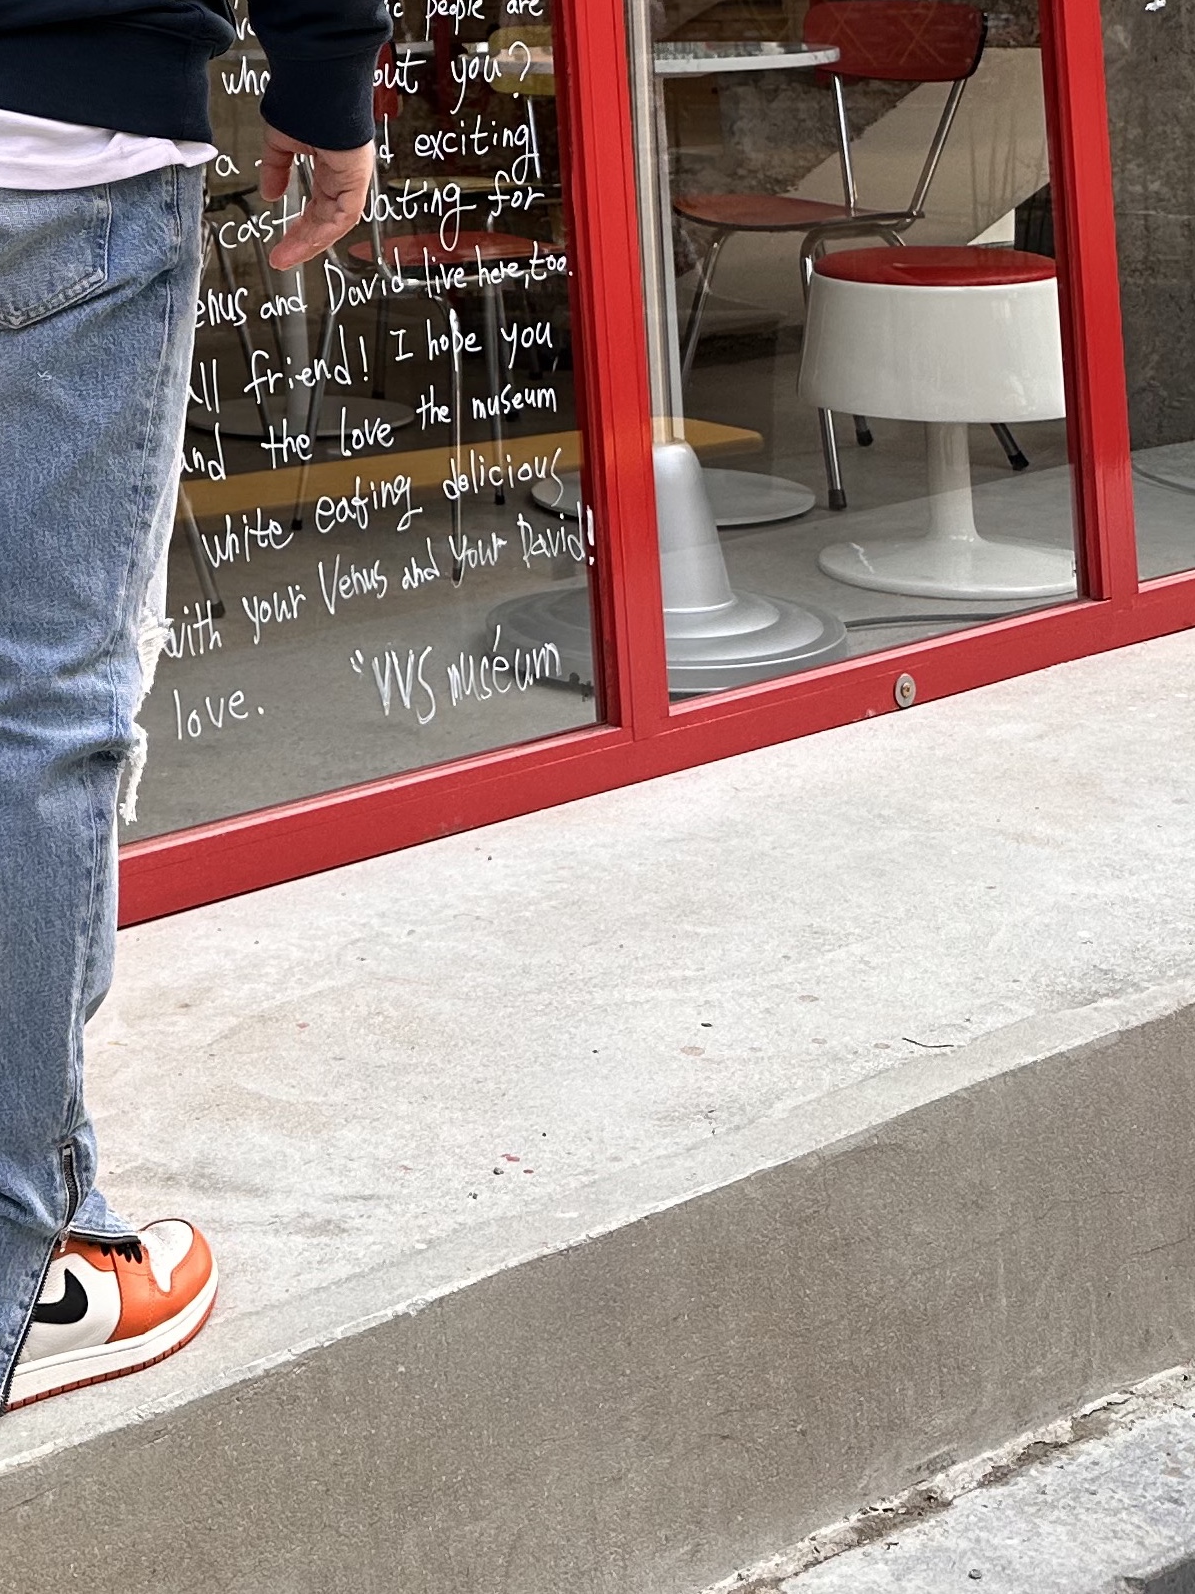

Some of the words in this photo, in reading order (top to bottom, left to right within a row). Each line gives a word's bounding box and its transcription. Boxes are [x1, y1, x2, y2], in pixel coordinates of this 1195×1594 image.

[450, 41, 532, 114] you?
[415, 115, 539, 185] exciting
[219, 195, 307, 248] cast
[488, 170, 545, 217] for
[195, 287, 248, 328] enus
[260, 271, 308, 319] and
[243, 324, 369, 405] friend!
[389, 329, 414, 362] I
[426, 308, 482, 372] hope
[260, 418, 313, 469] the
[341, 407, 395, 457] love
[416, 385, 452, 431] the
[472, 384, 558, 420] museum
[318, 553, 388, 615] Venus
[402, 537, 441, 590] and
[174, 689, 264, 740] love.
